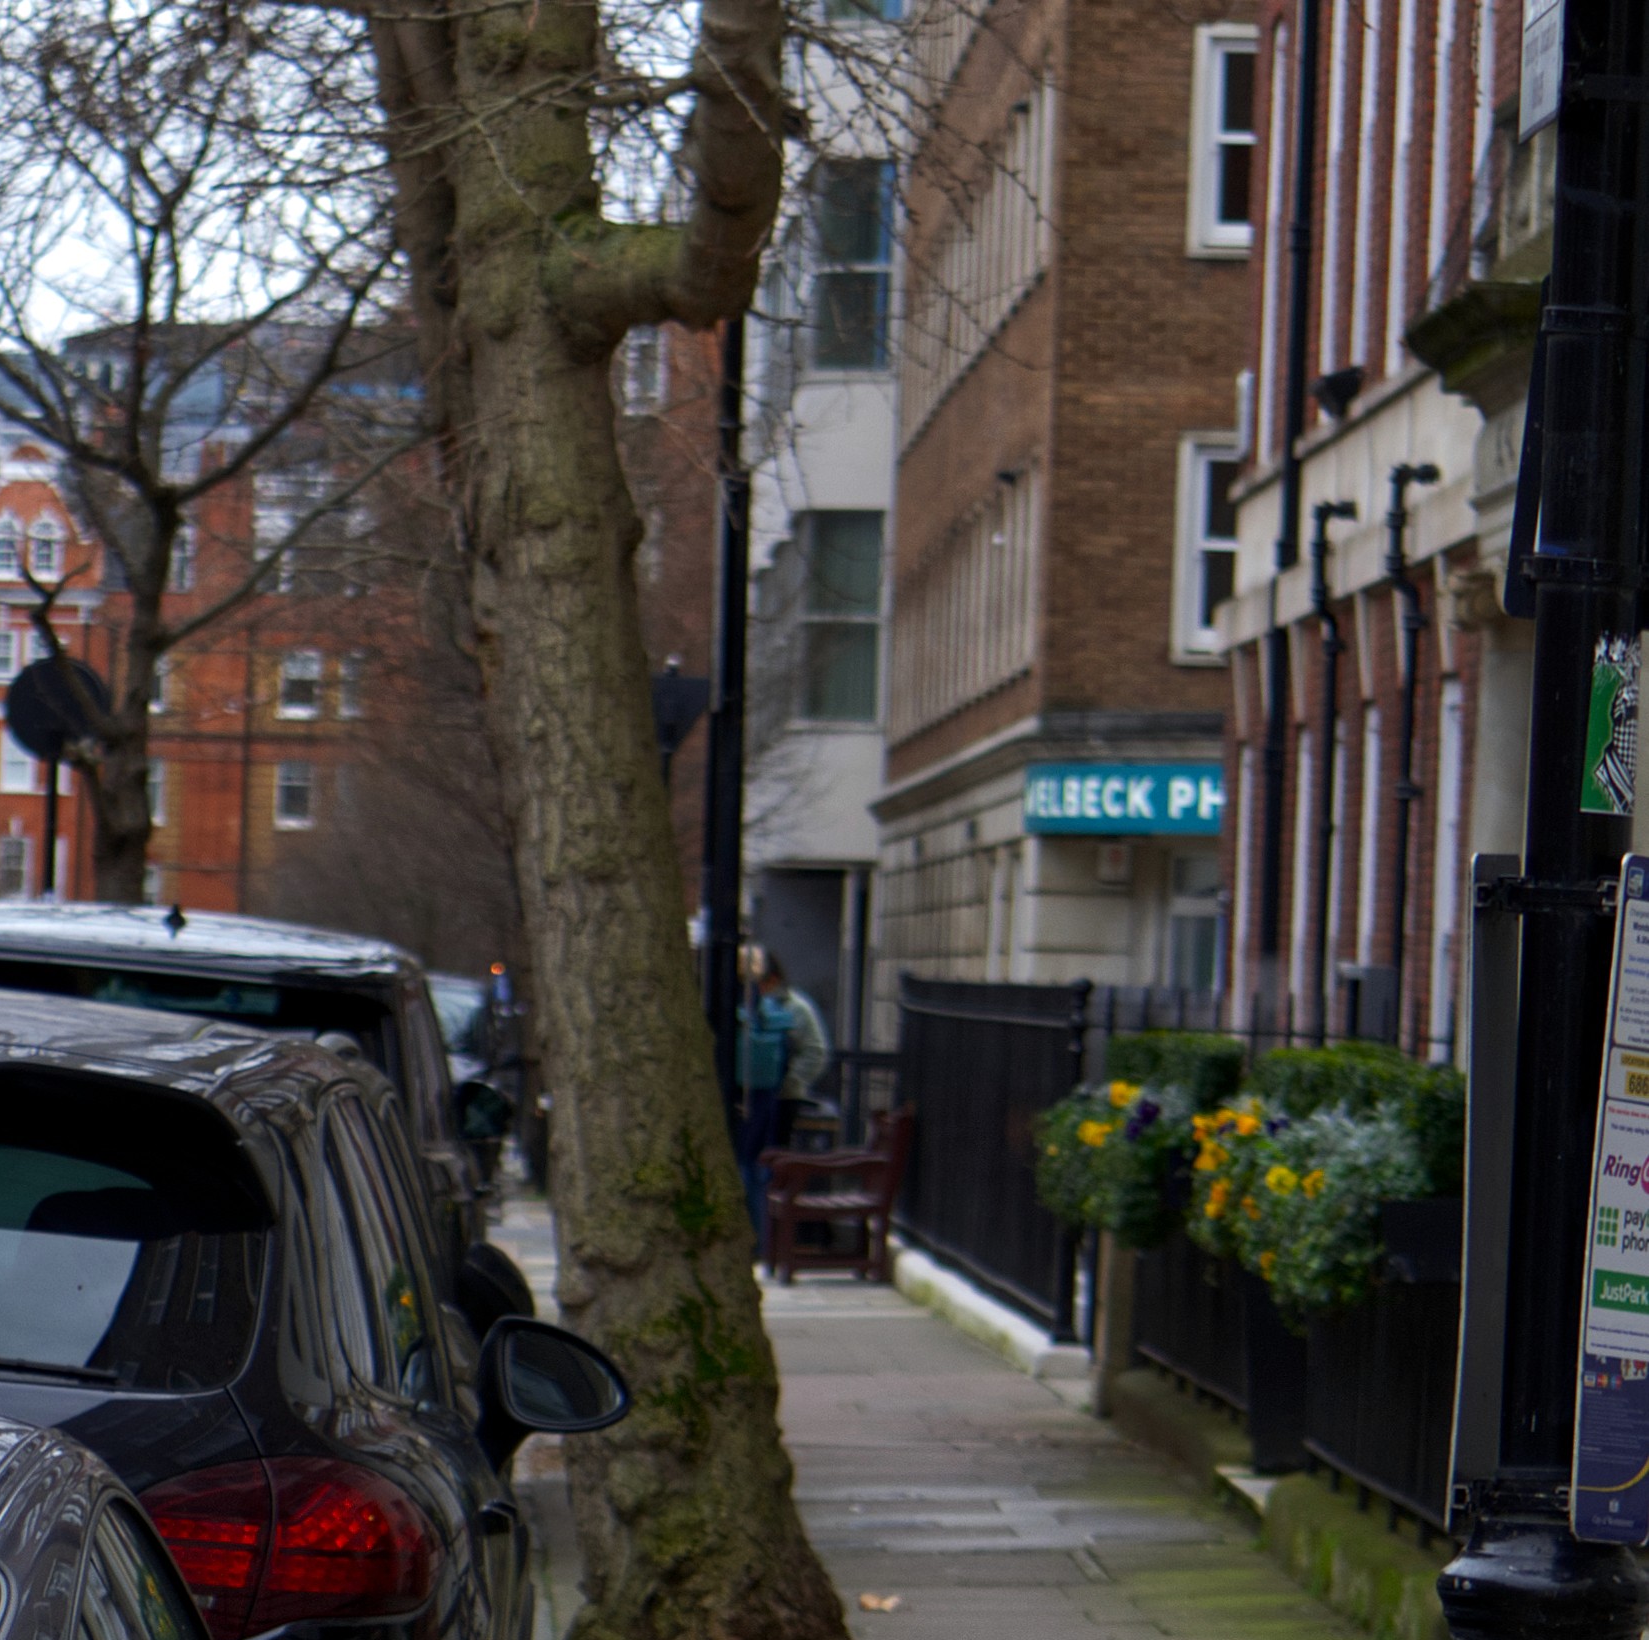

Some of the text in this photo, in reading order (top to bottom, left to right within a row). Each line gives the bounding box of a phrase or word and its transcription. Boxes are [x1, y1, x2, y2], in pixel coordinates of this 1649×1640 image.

[1168, 776, 1225, 819] PH
[1629, 1073, 1649, 1095] 686
[1603, 1154, 1647, 1188] Ring
[1599, 1279, 1649, 1305] JustPark
